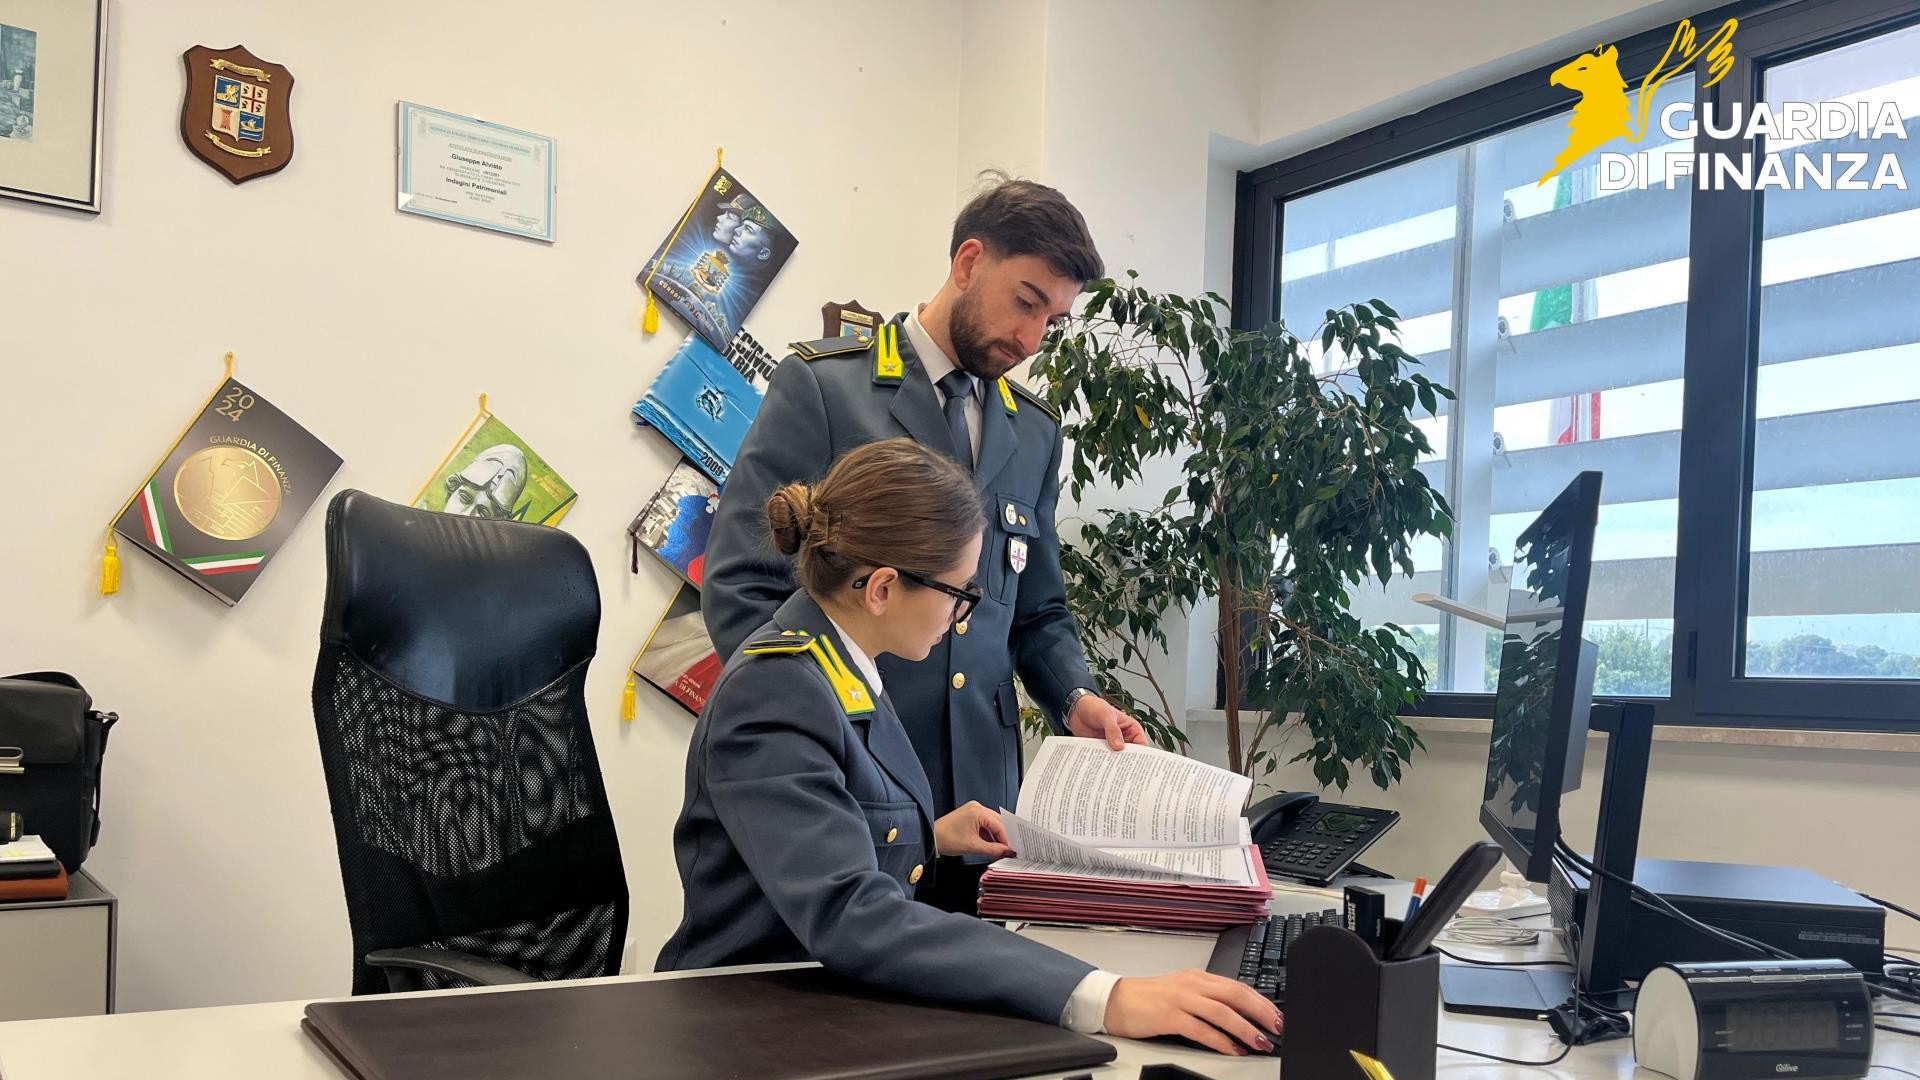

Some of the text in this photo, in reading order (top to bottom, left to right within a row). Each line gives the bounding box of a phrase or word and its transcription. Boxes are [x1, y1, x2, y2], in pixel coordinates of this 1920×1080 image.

[451, 153, 480, 165] Giuseppe
[445, 177, 507, 196] Indagini Patrimoniali
[225, 386, 255, 410] 20
[215, 399, 244, 422] 24
[209, 435, 292, 496] GUARDIA DI FINANZA
[700, 451, 725, 477] 2009
